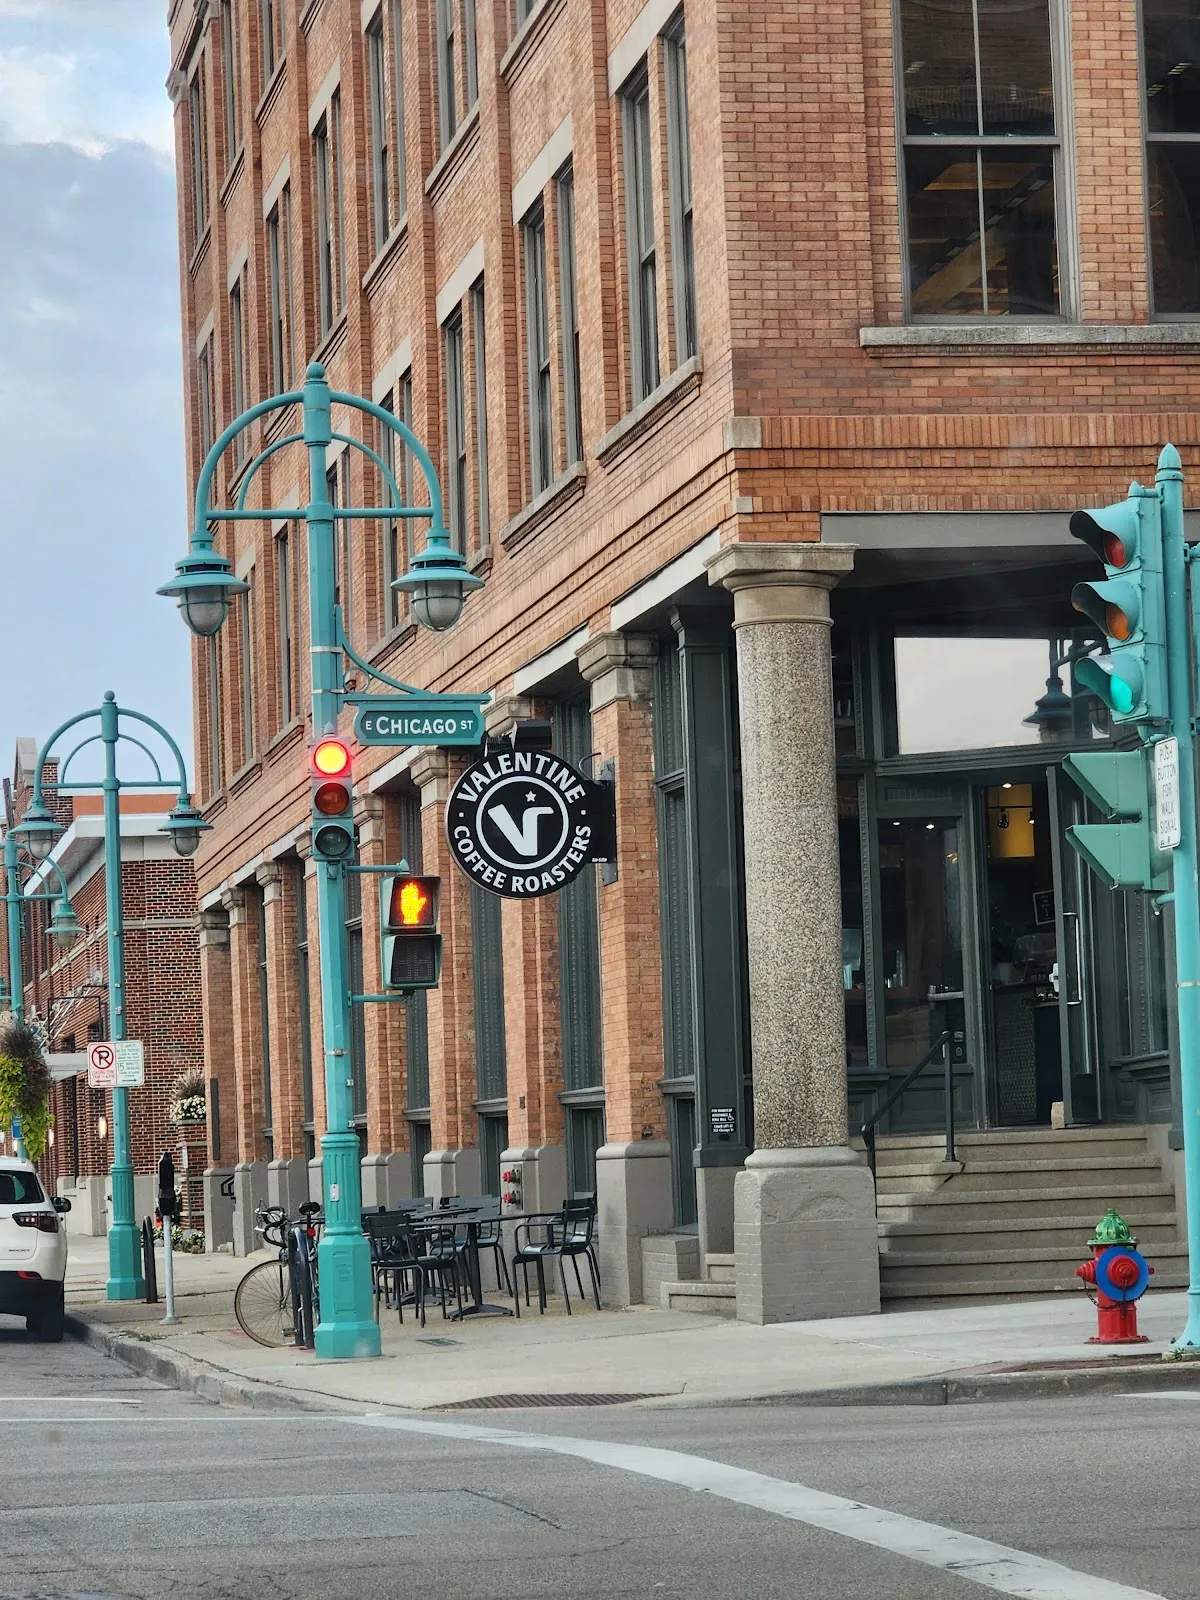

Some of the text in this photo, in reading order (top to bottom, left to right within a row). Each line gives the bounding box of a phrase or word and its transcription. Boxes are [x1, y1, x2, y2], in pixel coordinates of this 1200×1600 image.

[365, 716, 473, 734] E CHICAGO ST
[456, 752, 586, 803] VALENTINE
[453, 824, 591, 893] COFFEE ROASTERS
